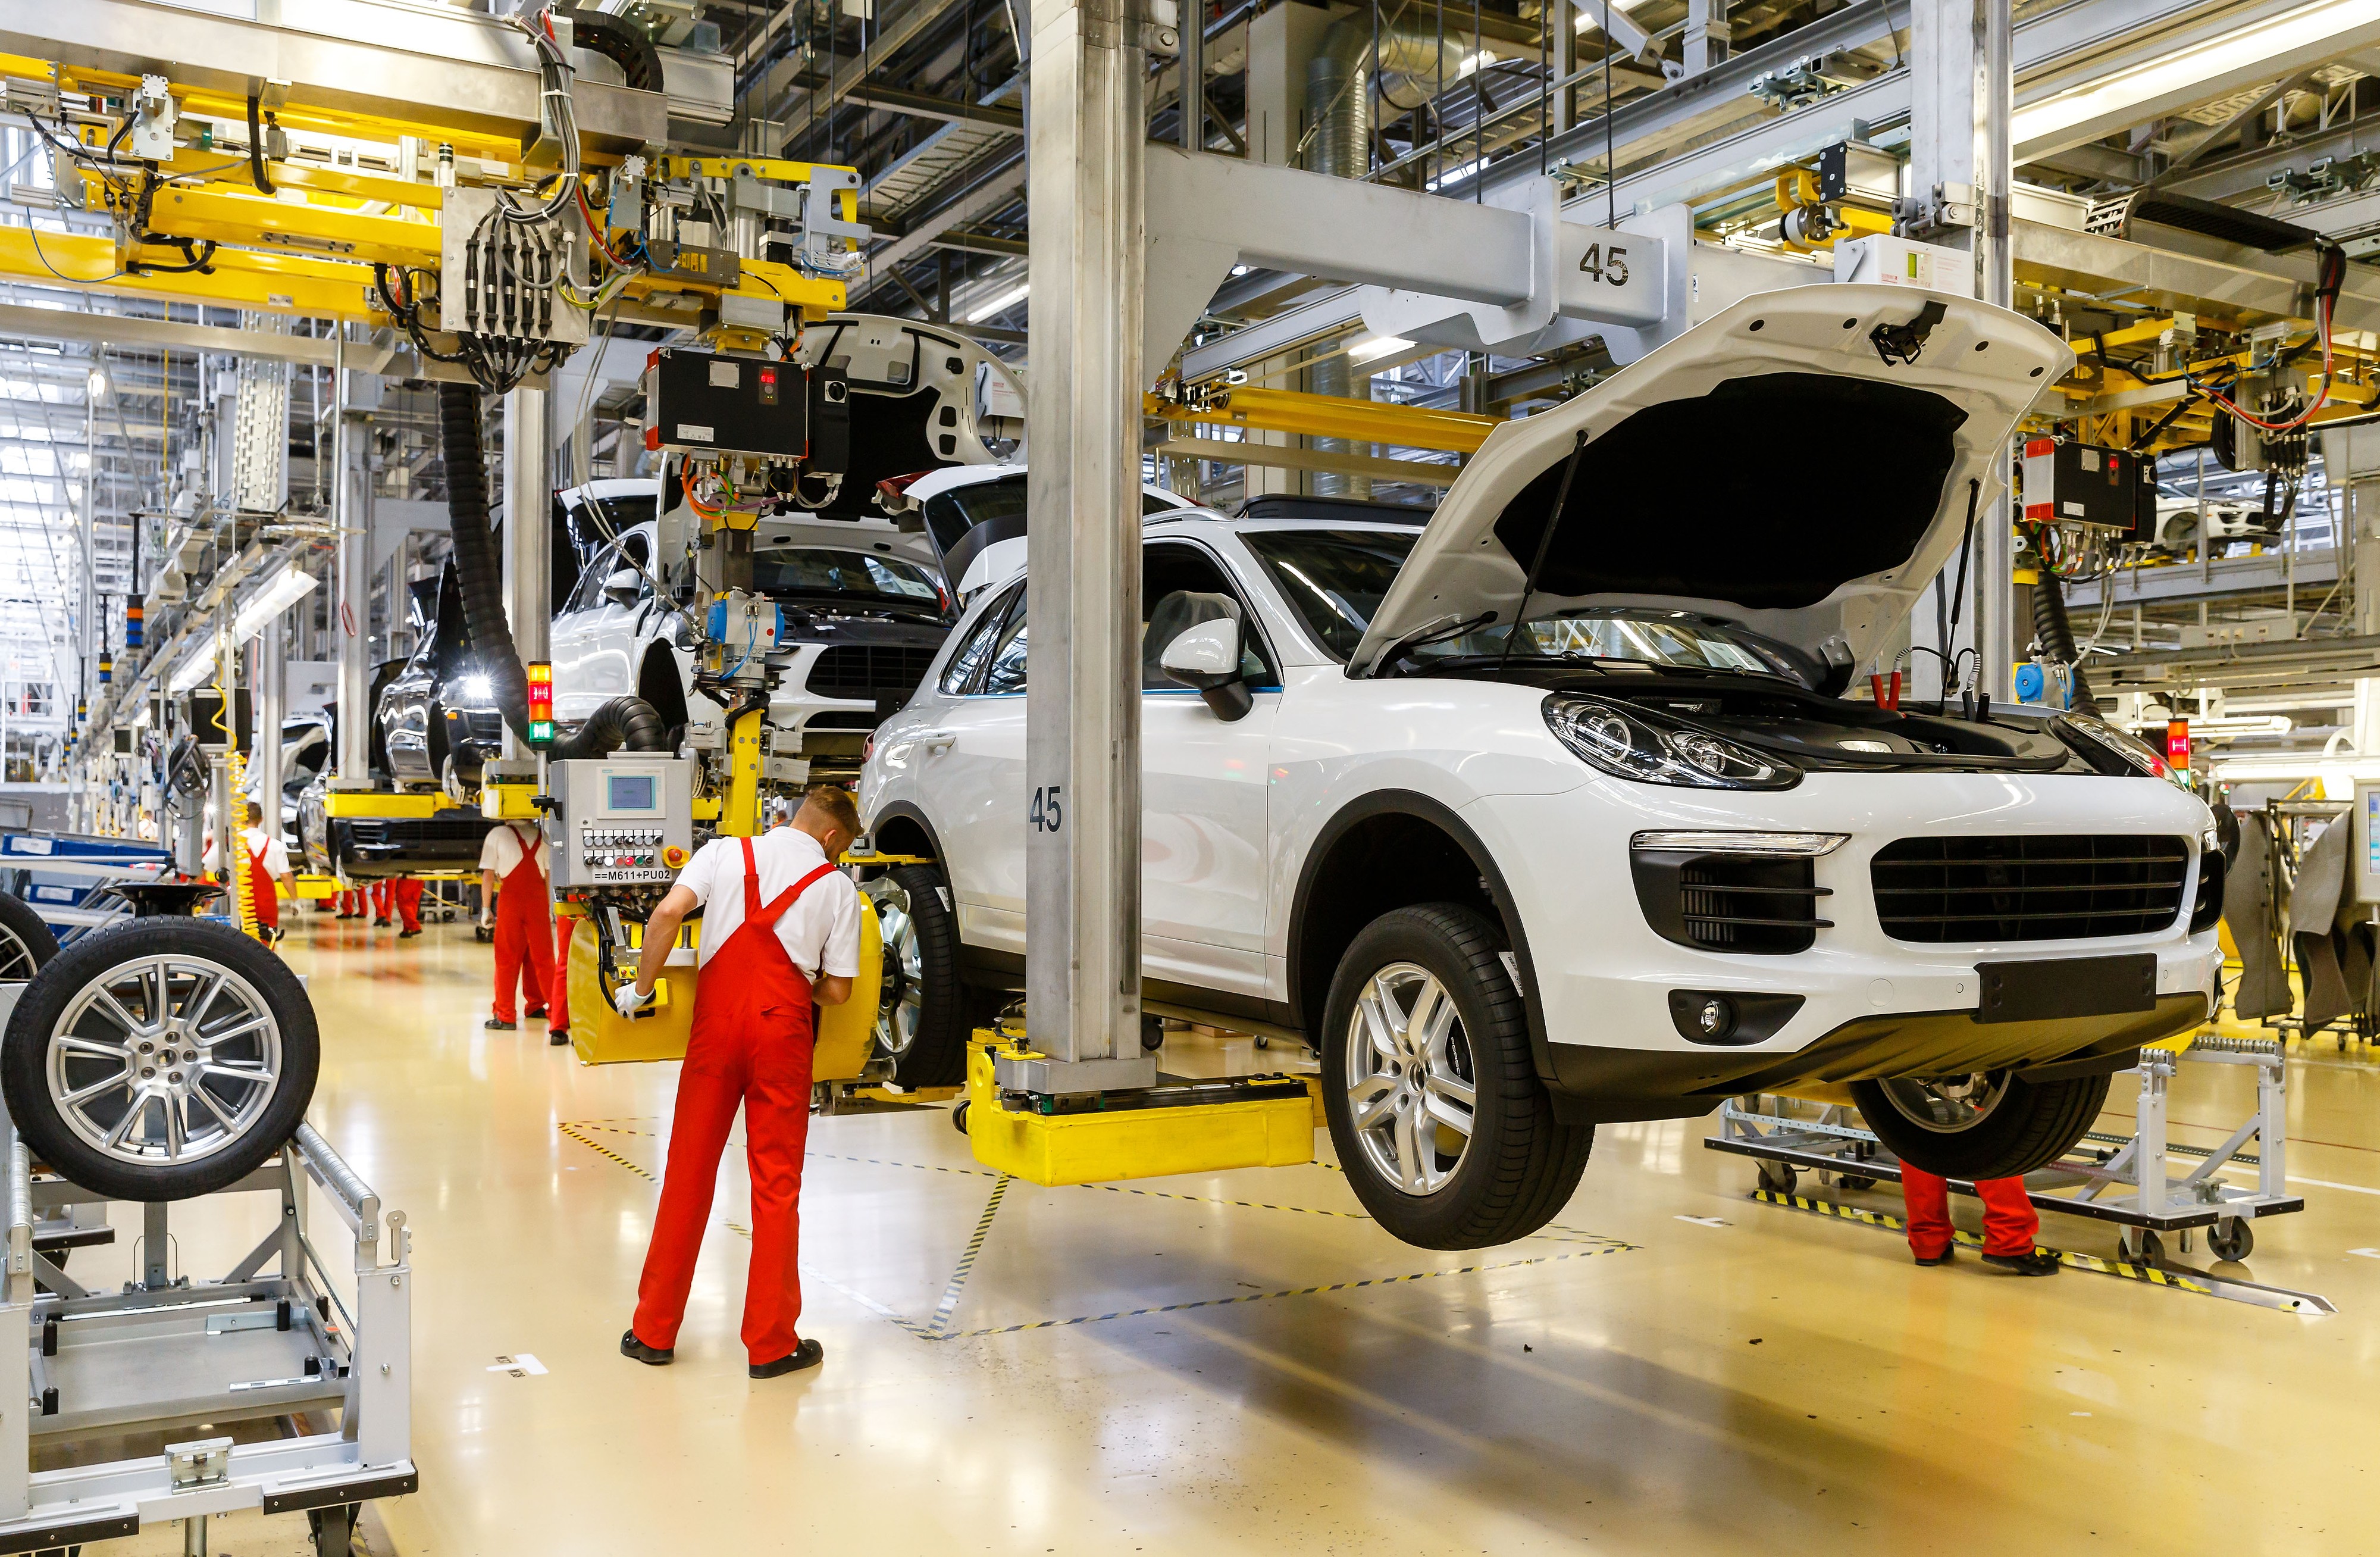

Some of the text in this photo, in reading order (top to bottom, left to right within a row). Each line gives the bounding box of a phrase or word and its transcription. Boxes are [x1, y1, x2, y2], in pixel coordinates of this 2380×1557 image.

[1580, 243, 1628, 286] 45
[1030, 786, 1062, 832] 45
[595, 870, 670, 880] ==M611+PU02
[1451, 1037, 1461, 1077] PORSC
